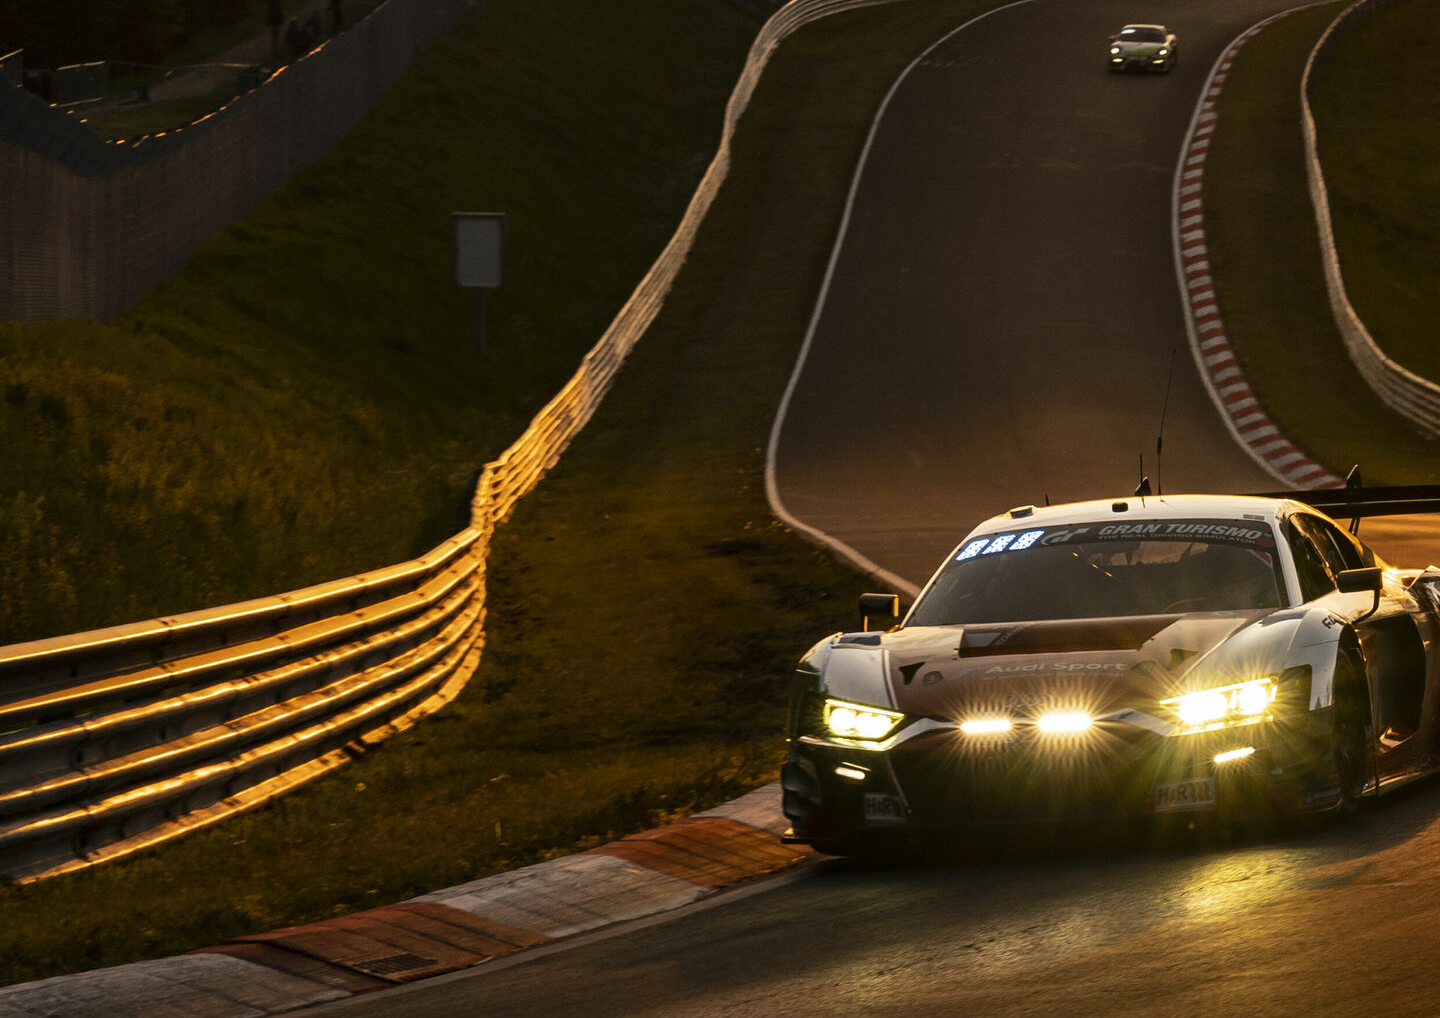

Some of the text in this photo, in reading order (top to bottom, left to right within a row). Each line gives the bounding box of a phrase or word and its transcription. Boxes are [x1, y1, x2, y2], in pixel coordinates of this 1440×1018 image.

[1098, 523, 1263, 540] GRAN TURISMO
[1195, 533, 1256, 545] SIMULATOR
[984, 662, 1127, 673] Audi Sport
